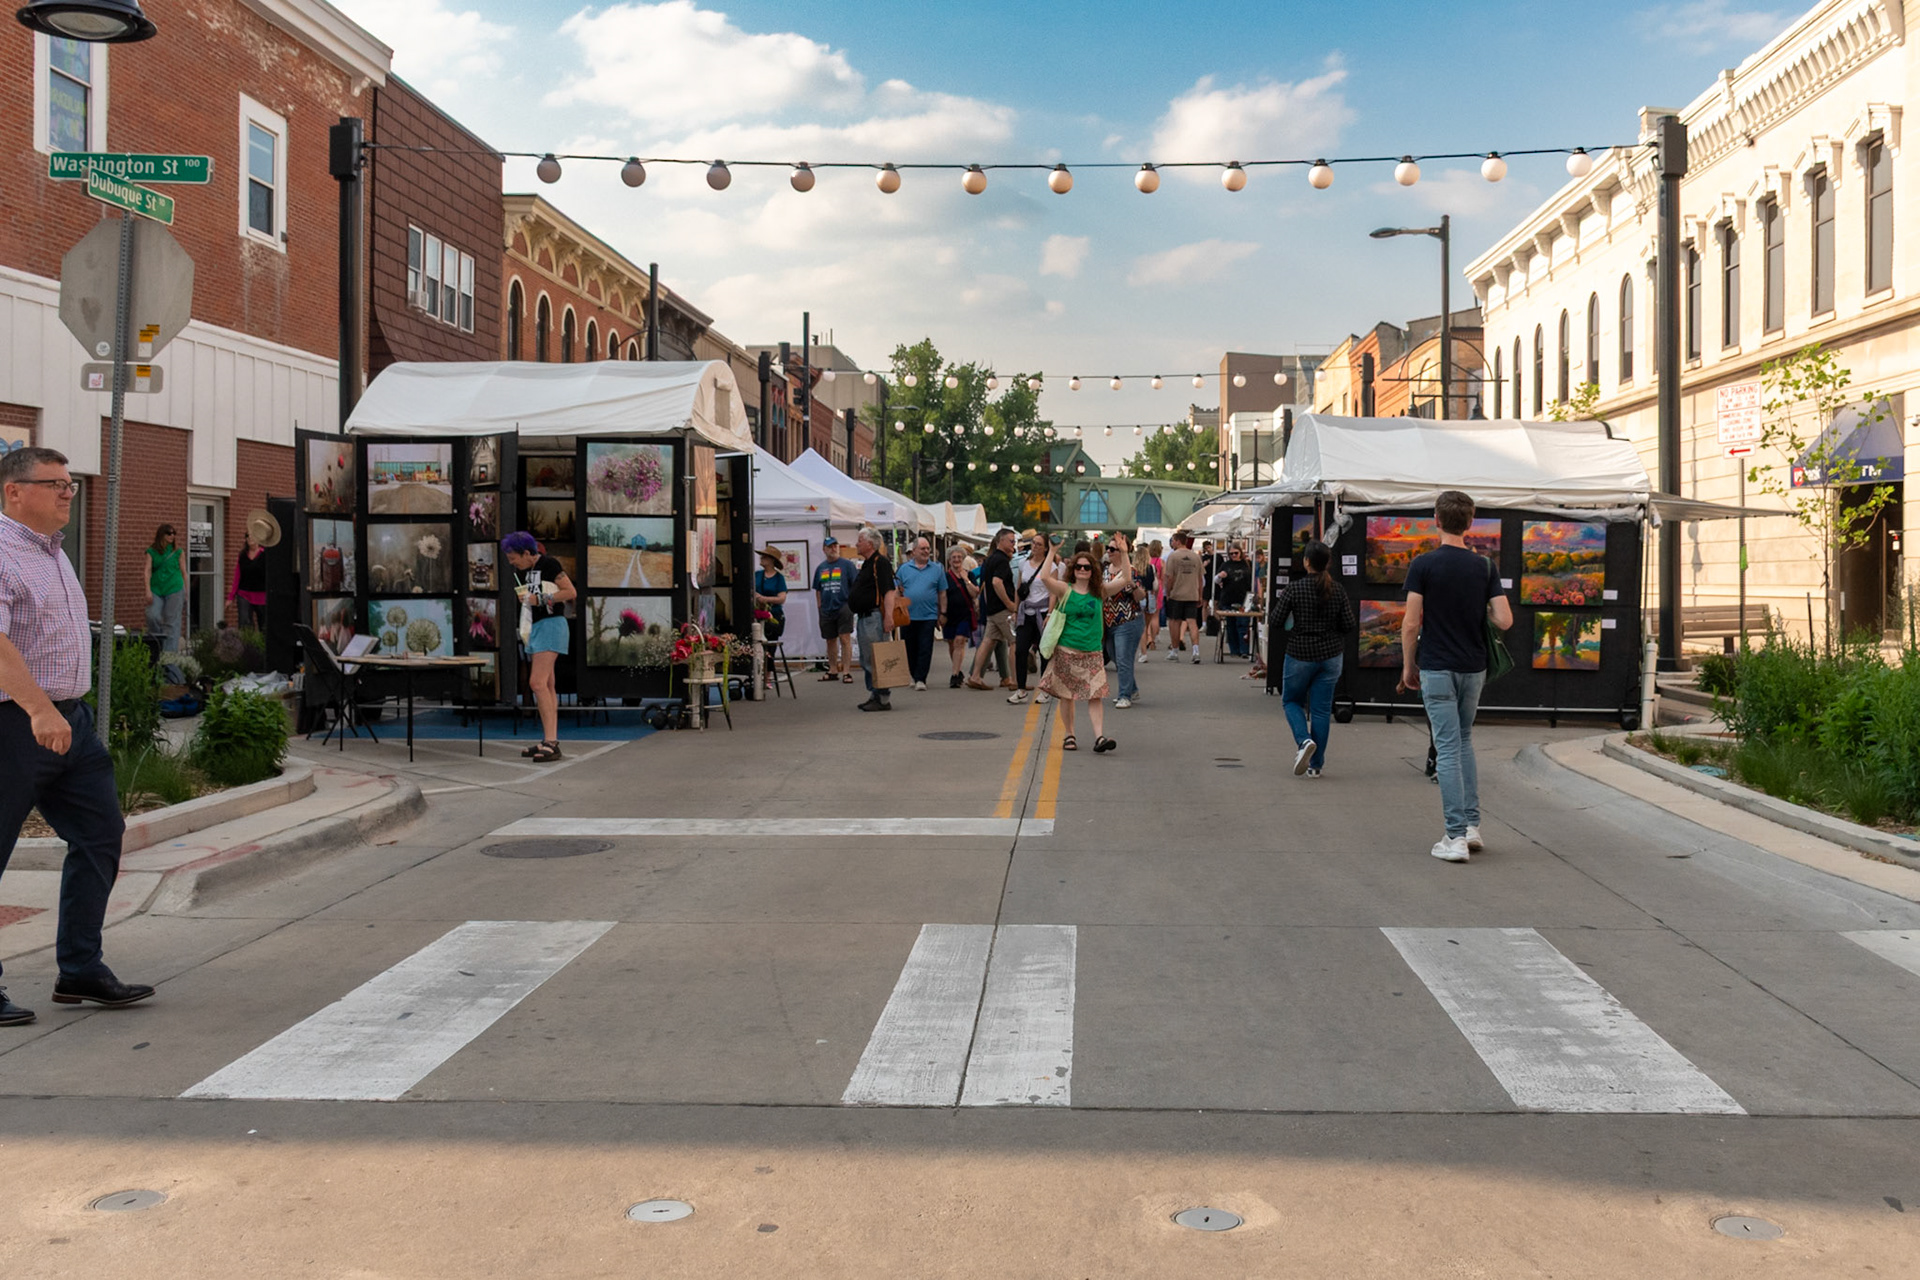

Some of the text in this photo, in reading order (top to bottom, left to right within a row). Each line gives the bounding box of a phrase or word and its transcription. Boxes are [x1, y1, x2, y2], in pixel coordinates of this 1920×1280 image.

[53, 156, 200, 177] Washington St 100
[91, 172, 142, 204] Dubuque
[145, 194, 156, 211] St
[1720, 384, 1758, 398] NO PARKING
